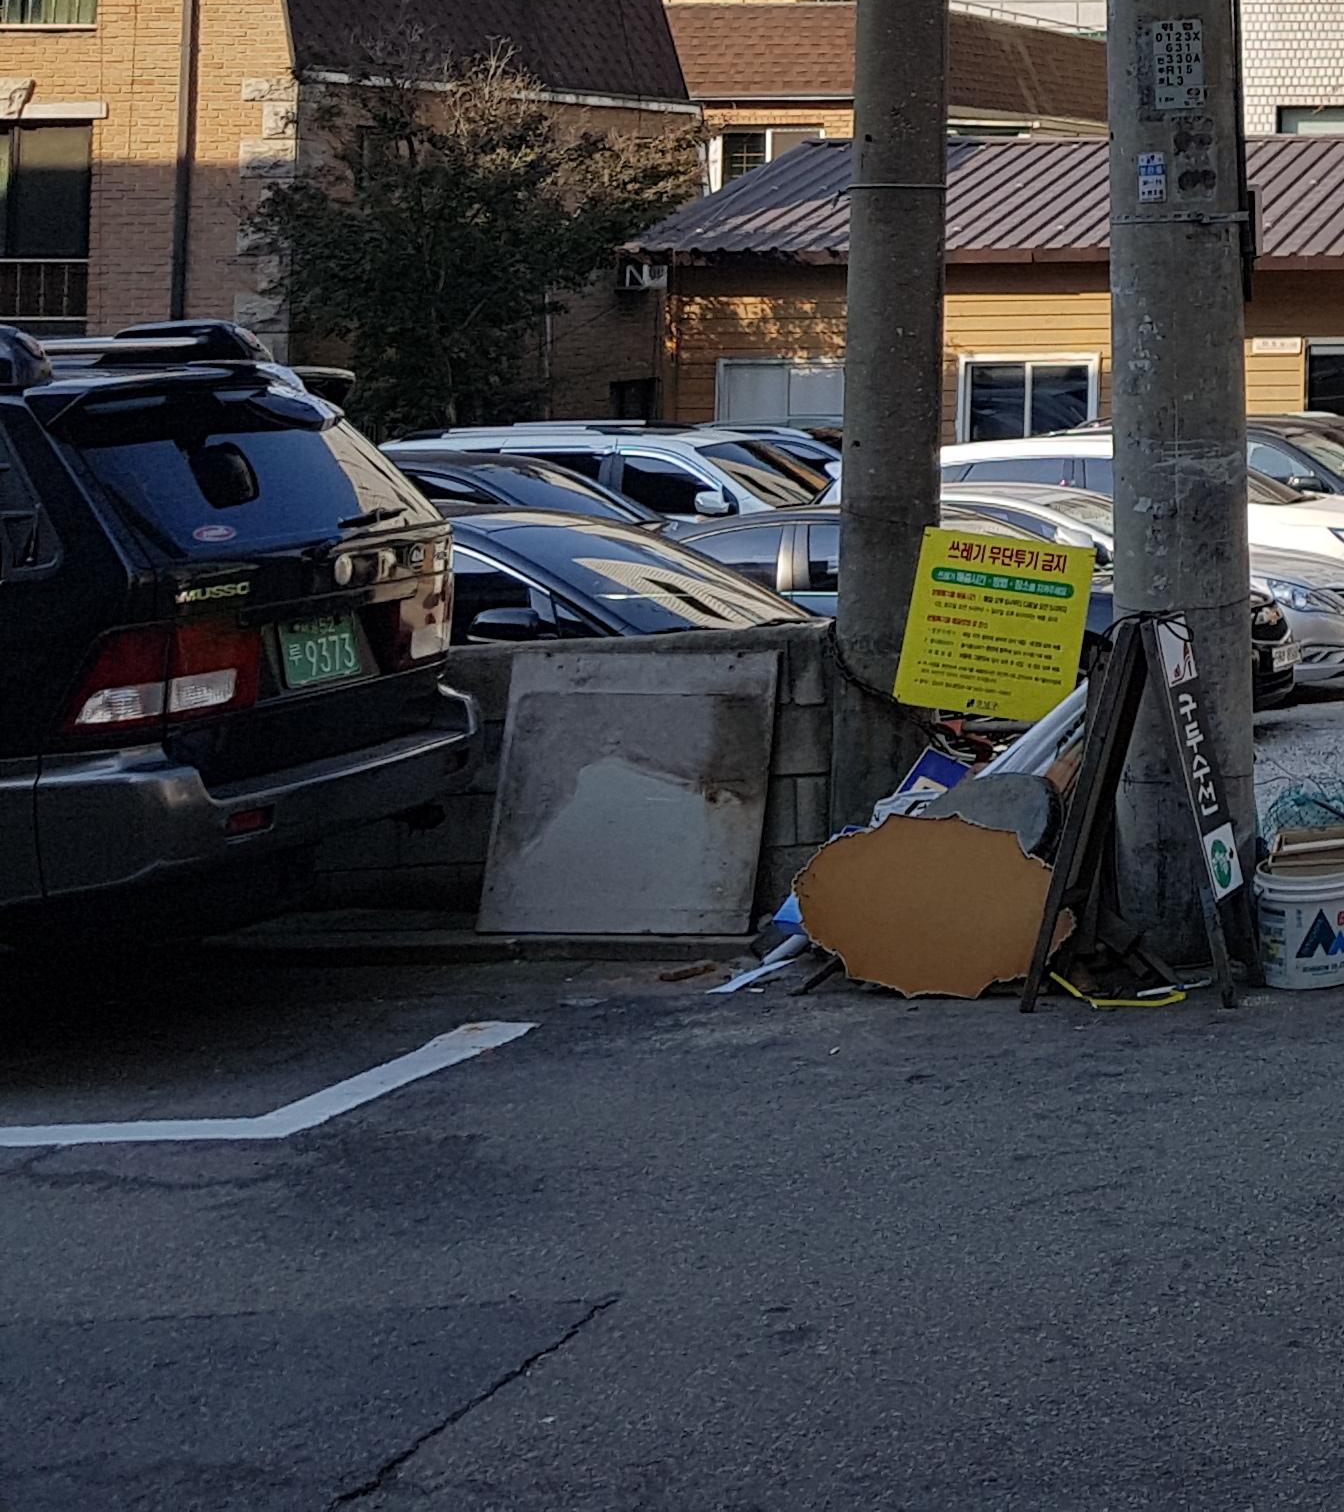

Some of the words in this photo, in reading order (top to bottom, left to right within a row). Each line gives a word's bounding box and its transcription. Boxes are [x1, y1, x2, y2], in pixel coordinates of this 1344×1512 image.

[948, 540, 986, 563] 쓰레기
[988, 546, 1040, 571] 무단투기
[1041, 554, 1068, 573] 금지
[176, 581, 250, 604] MUSSO
[1178, 693, 1219, 817] 구두수선
